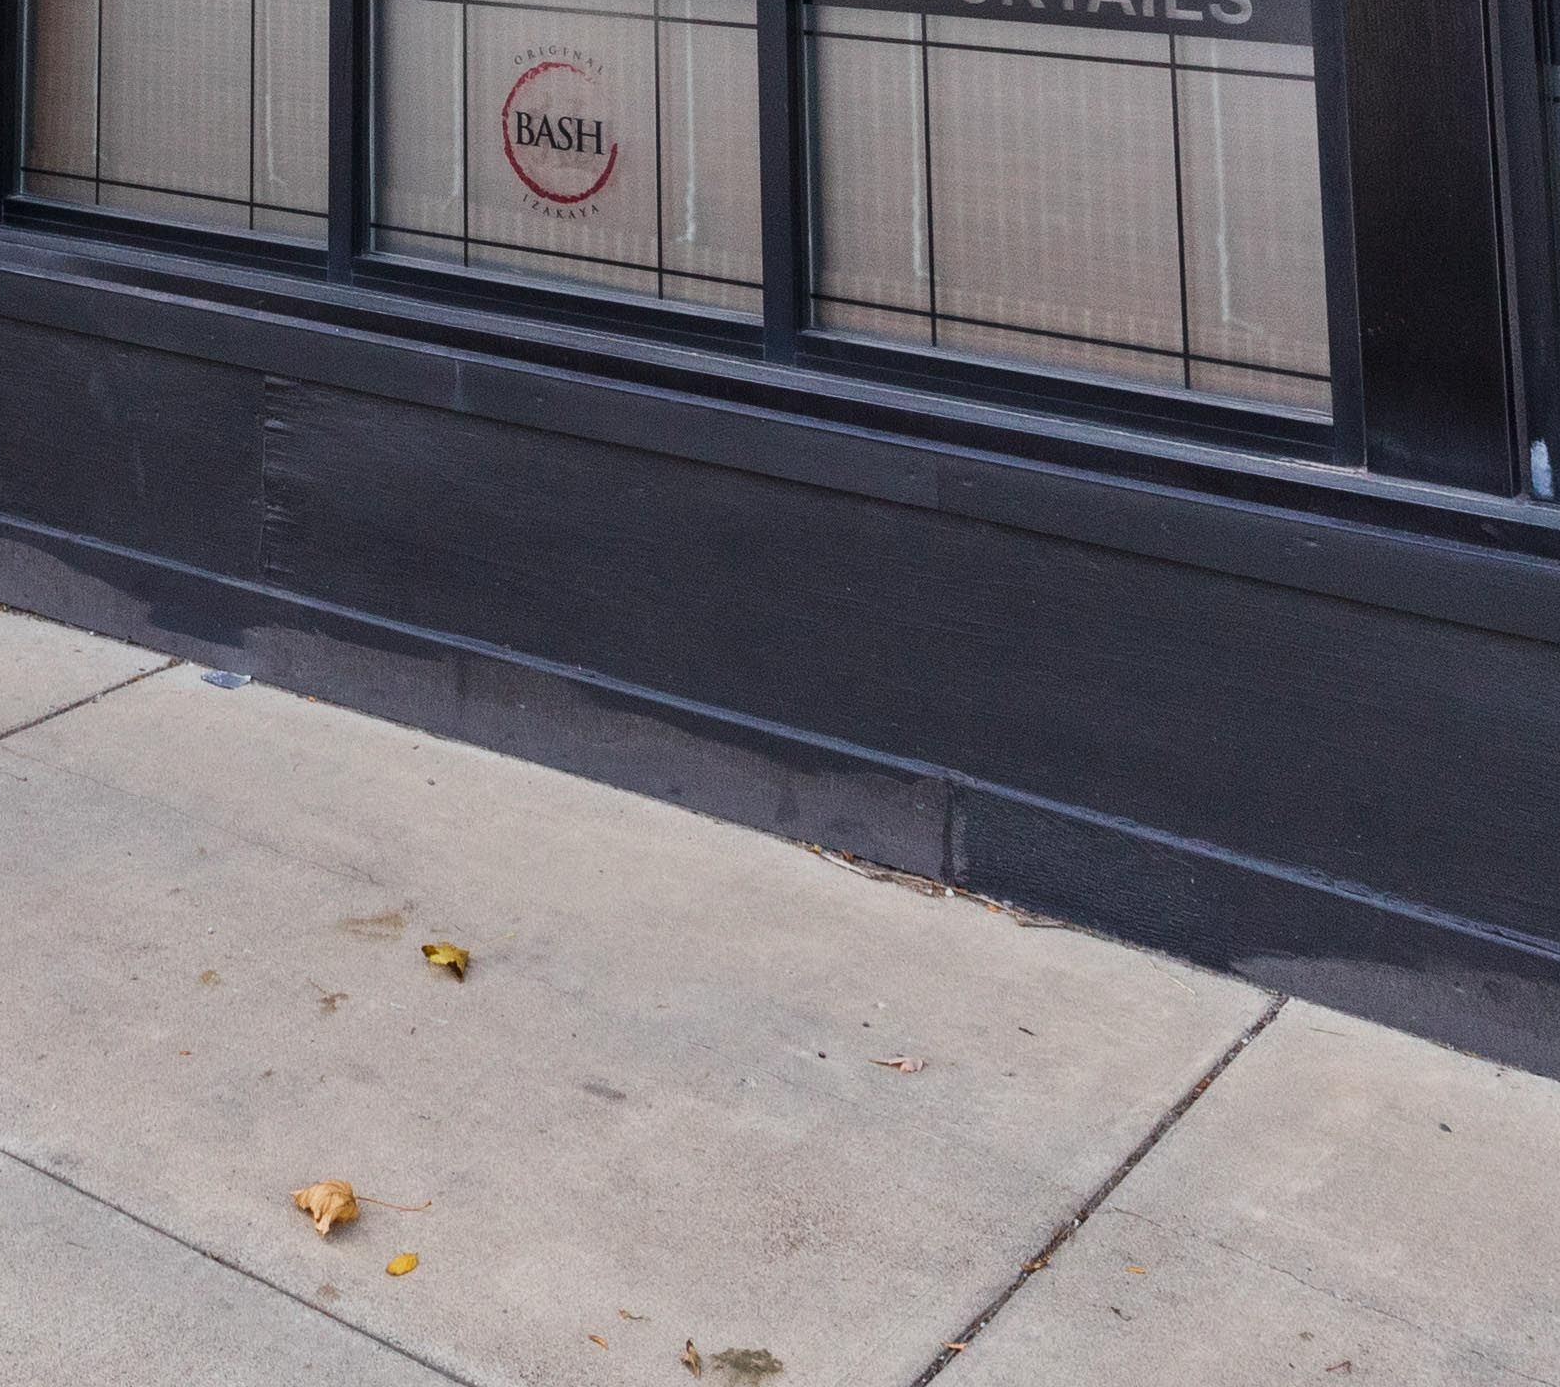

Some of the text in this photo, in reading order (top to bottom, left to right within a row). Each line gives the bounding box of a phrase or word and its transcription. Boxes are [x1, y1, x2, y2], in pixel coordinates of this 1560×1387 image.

[513, 44, 606, 76] ORIGINAL
[515, 110, 606, 156] BASH
[522, 193, 600, 220] IZAKAYA
